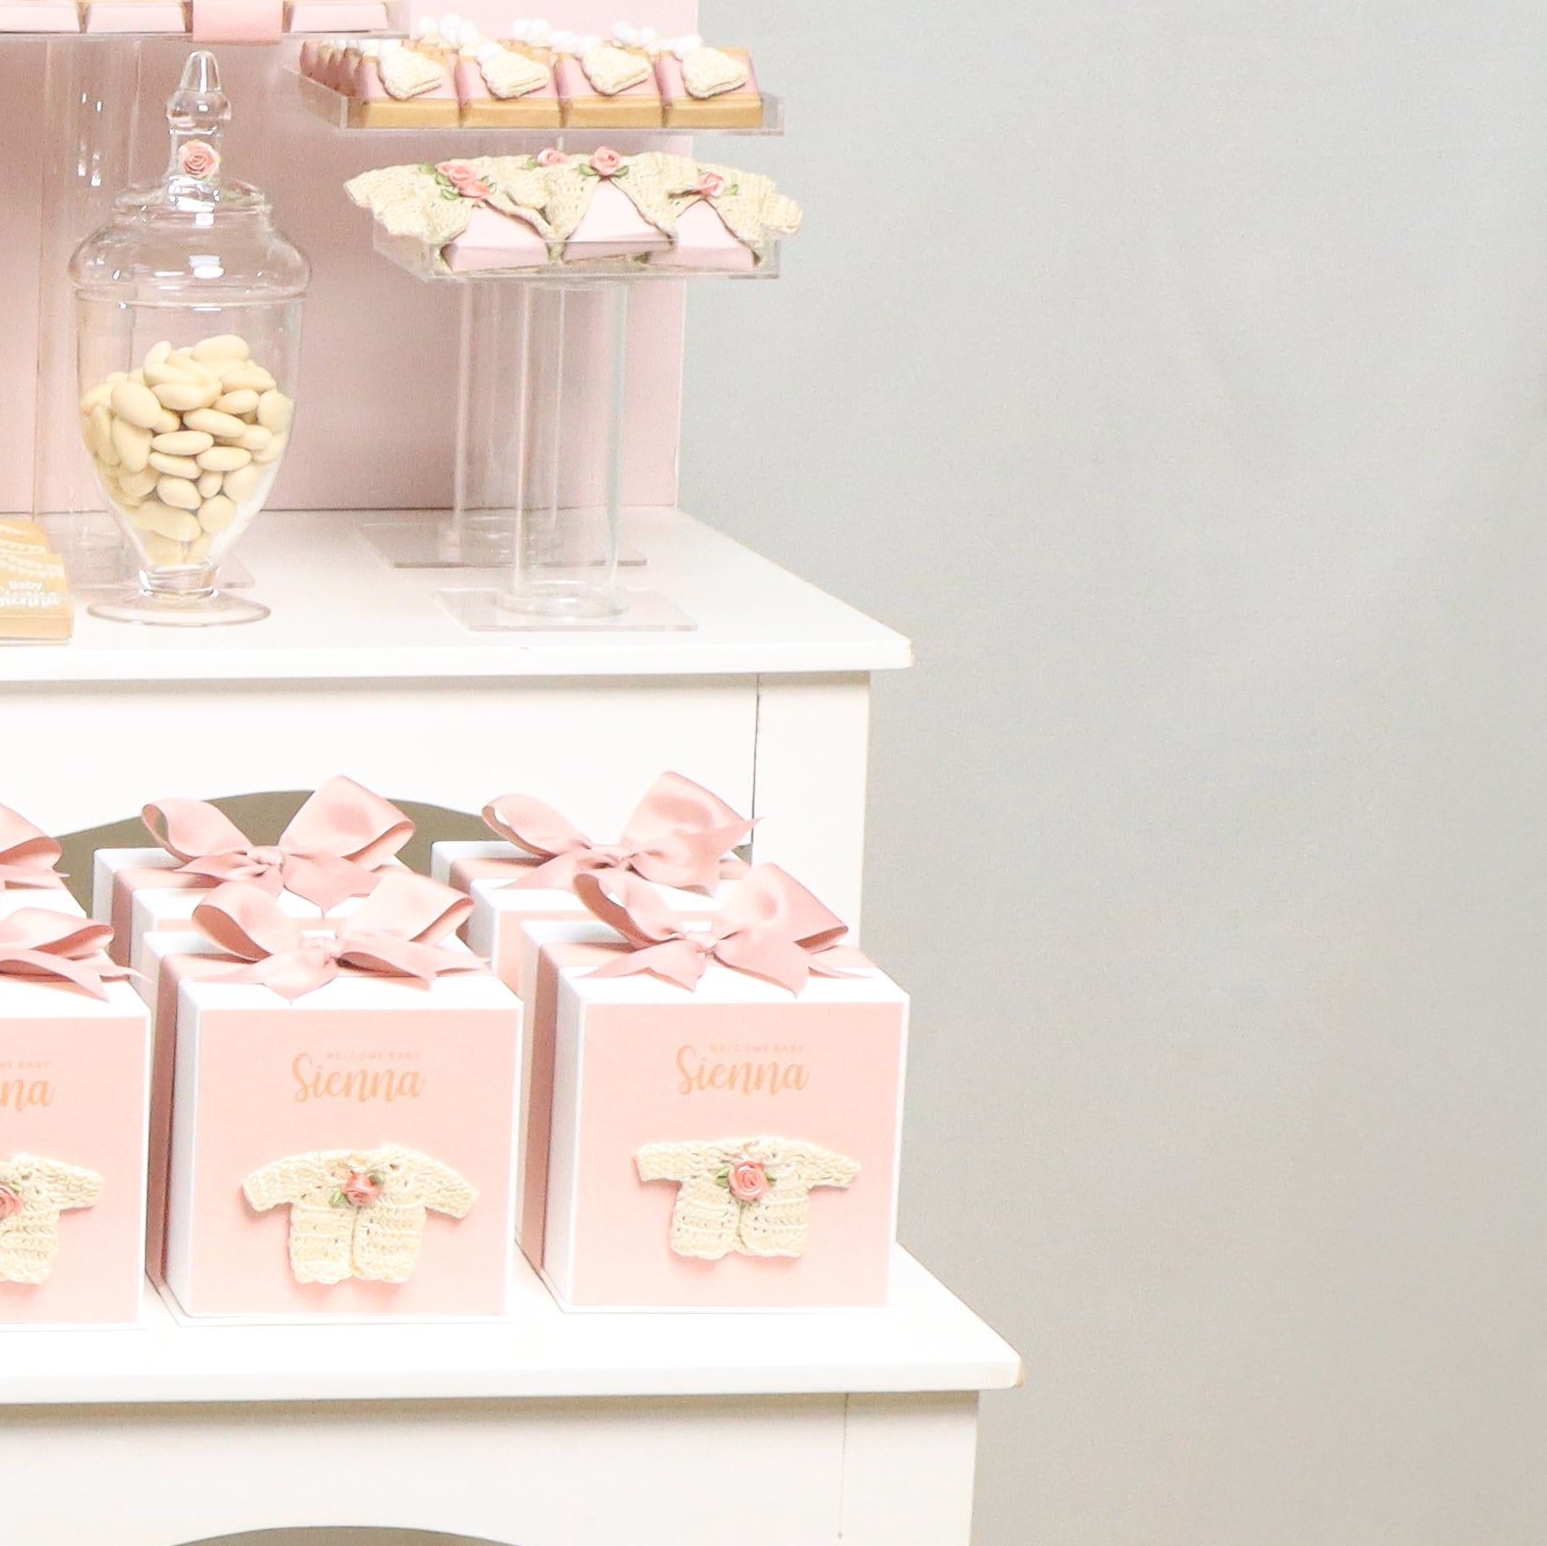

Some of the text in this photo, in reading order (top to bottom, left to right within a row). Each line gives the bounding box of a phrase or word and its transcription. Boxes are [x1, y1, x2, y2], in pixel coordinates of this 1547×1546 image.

[9, 580, 43, 591] Baby
[708, 1044, 805, 1053] WELCOME BABY
[325, 1052, 421, 1060] WELCOME BABY
[16, 1060, 52, 1069] BABY
[675, 1044, 811, 1096] Sienna
[291, 1052, 426, 1103] Sienna
